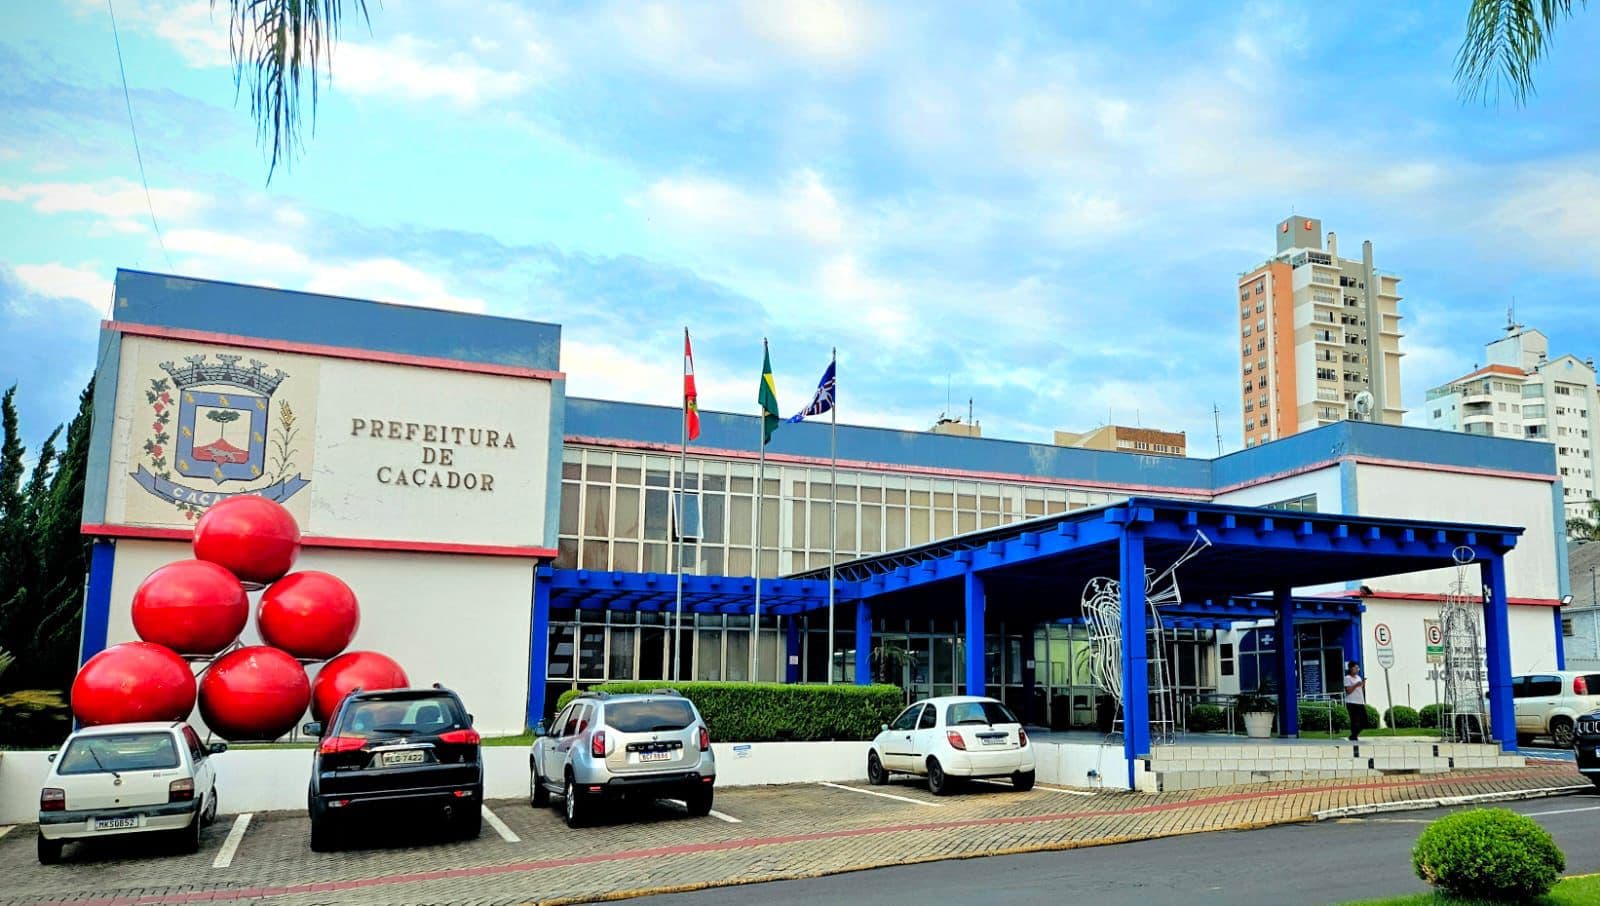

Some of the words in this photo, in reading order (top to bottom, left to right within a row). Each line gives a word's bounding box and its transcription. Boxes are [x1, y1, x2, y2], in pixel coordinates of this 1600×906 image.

[351, 418, 516, 448] PREFEITURA
[422, 447, 454, 466] DE
[1379, 627, 1387, 642] E
